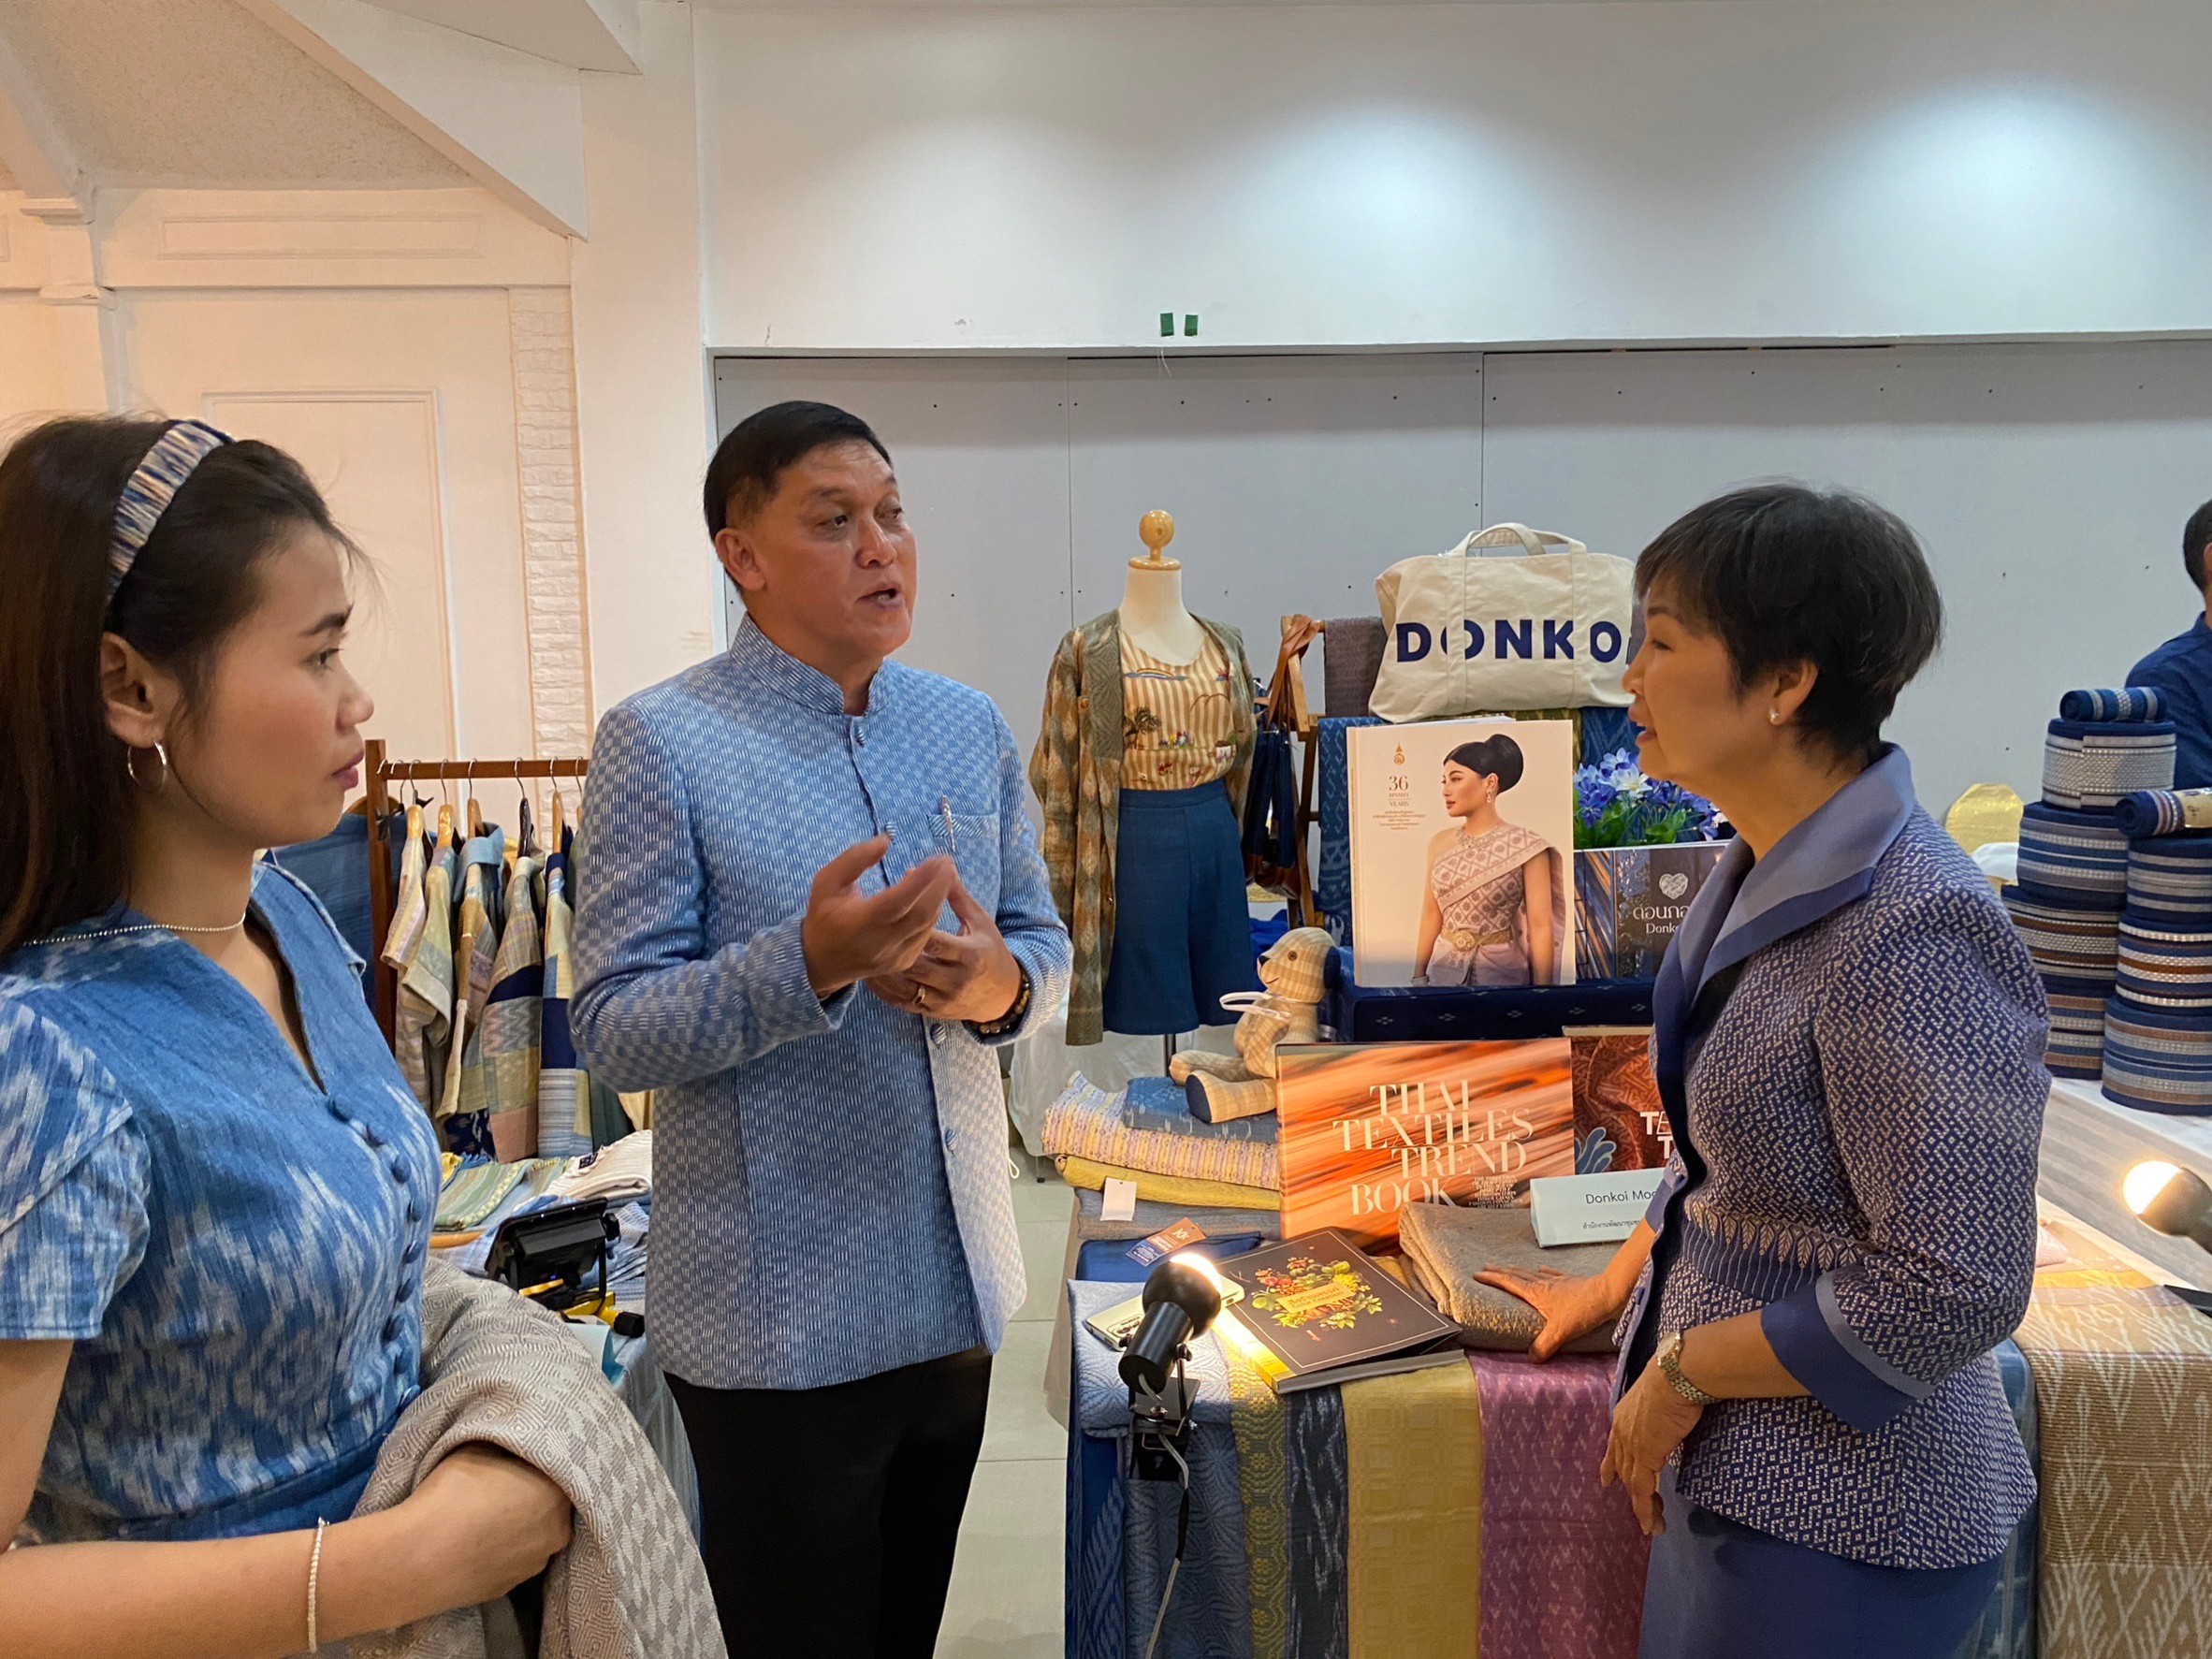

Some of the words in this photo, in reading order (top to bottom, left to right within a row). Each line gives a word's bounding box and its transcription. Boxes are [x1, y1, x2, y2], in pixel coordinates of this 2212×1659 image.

[1396, 618, 1631, 664] DONKO
[1389, 775, 1409, 792] 36
[1633, 905, 1690, 921] ดอนกอ
[1646, 923, 1681, 935] Donk
[1369, 1079, 1470, 1116] THAI
[1332, 1108, 1534, 1152] TEXTILES
[1391, 1141, 1527, 1179] TREND
[1351, 1177, 1461, 1215] BOOK
[1585, 1190, 1628, 1204] Donkoi
